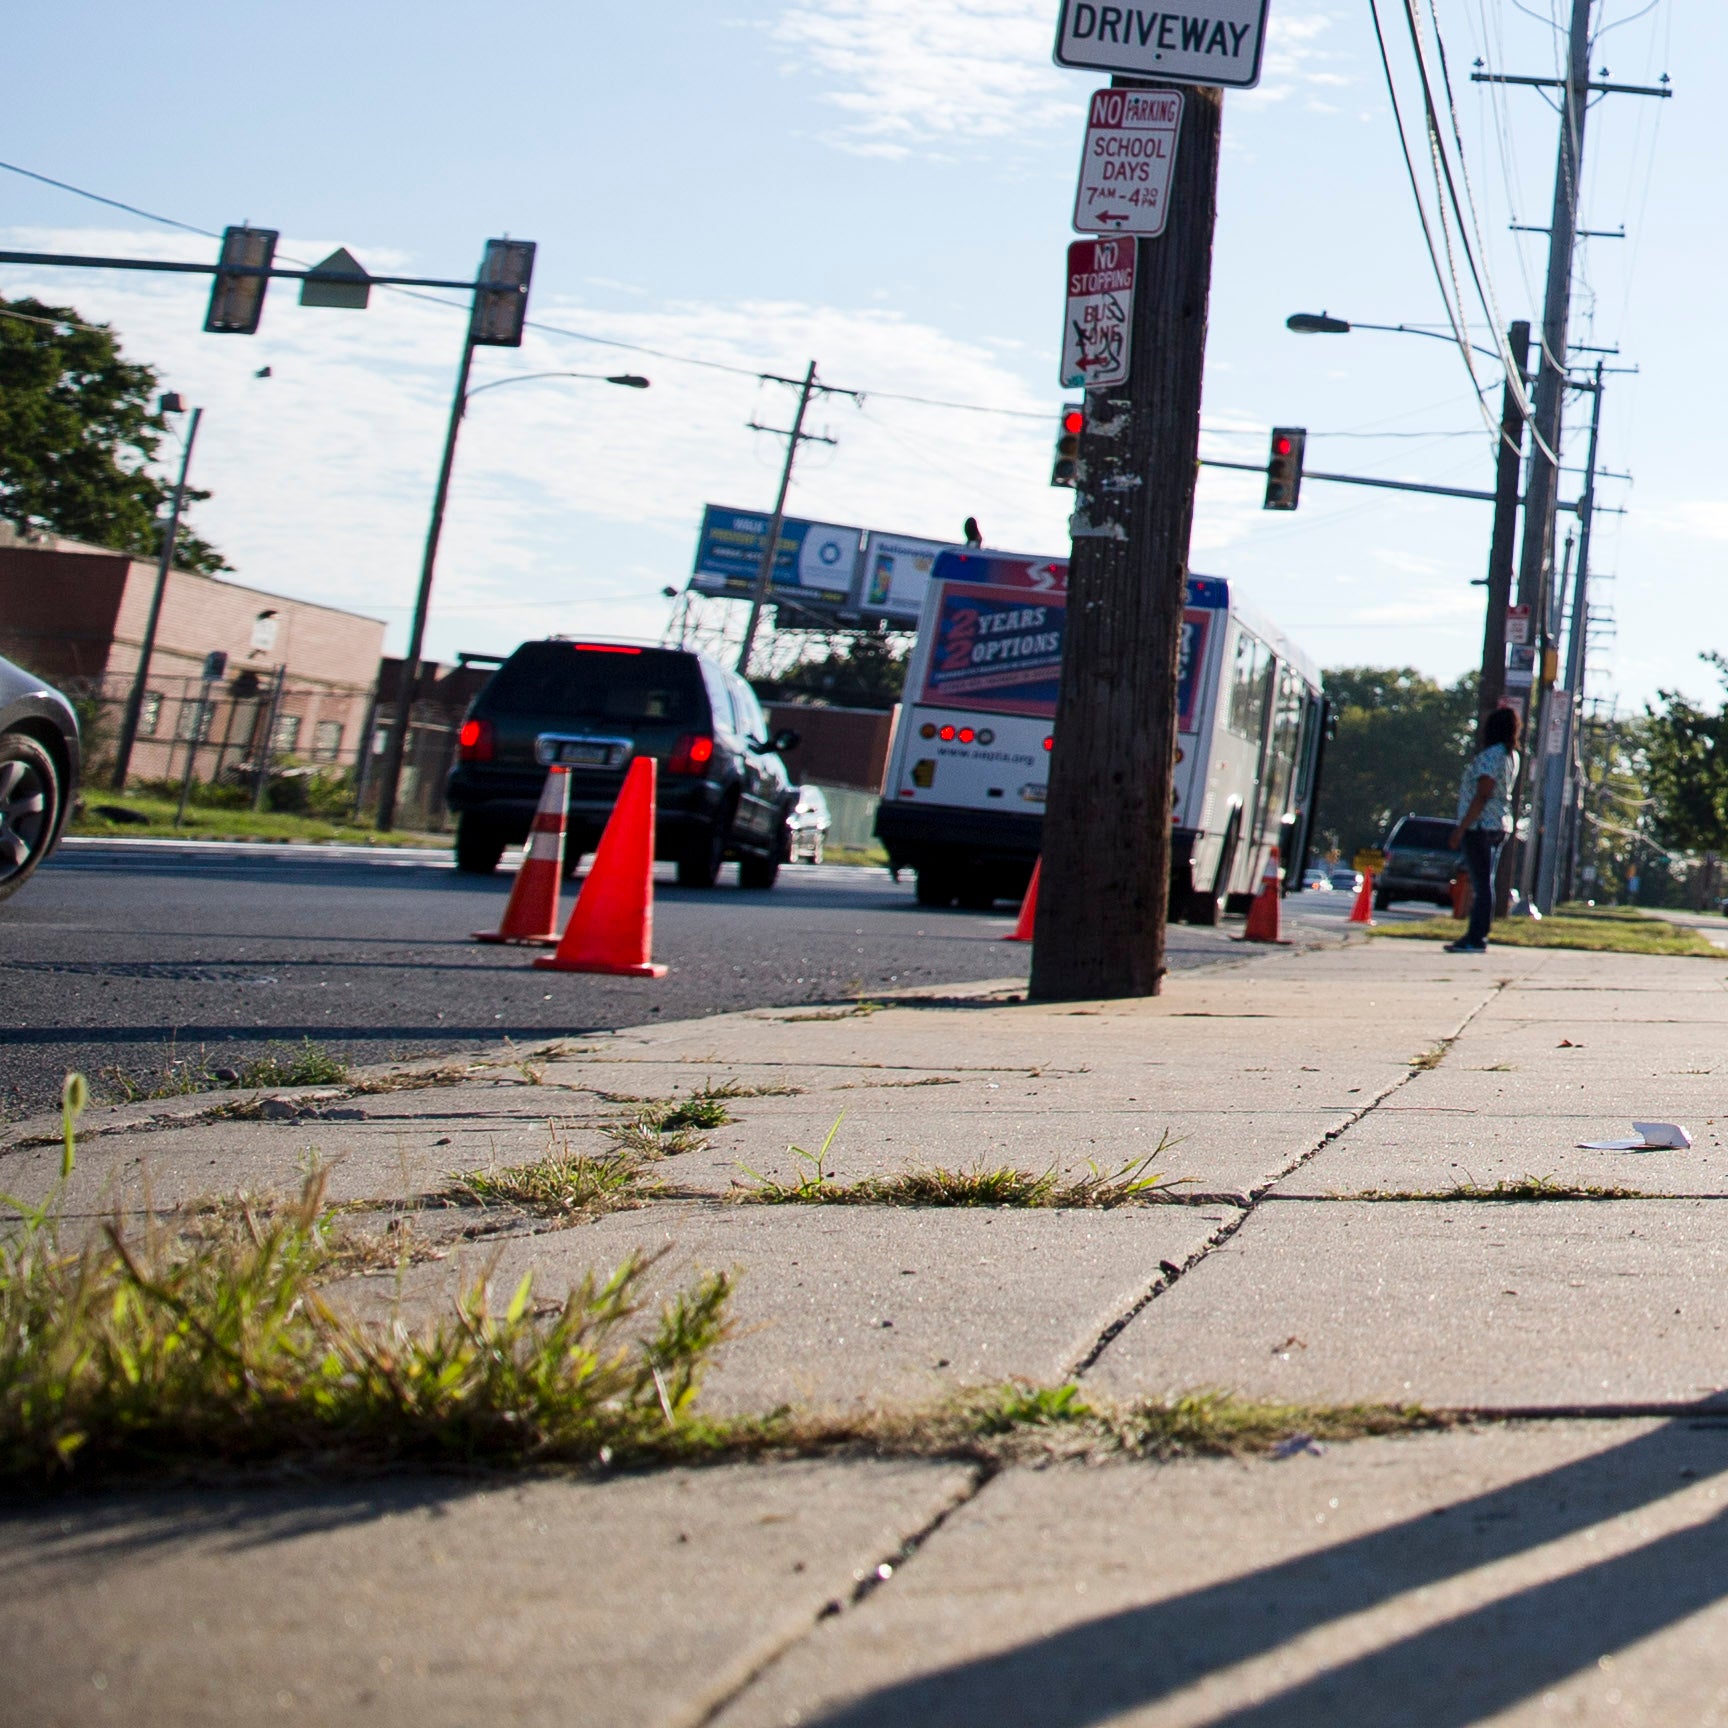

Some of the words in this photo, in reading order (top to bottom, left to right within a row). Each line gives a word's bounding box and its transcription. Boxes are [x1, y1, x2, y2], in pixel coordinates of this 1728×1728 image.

[1072, 3, 1250, 57] DRIVEWAY
[1093, 95, 1122, 125] NO
[1126, 100, 1177, 122] PARKING
[1094, 137, 1166, 158] SCHOOL
[1102, 161, 1150, 181] DAYS
[1094, 241, 1119, 270] NO
[1071, 268, 1132, 293] STOPPING
[1084, 305, 1116, 323] BUS
[947, 609, 979, 639] 2
[978, 607, 1047, 635] YEARS
[941, 640, 973, 669] 2
[971, 631, 1060, 663] OPTIONS
